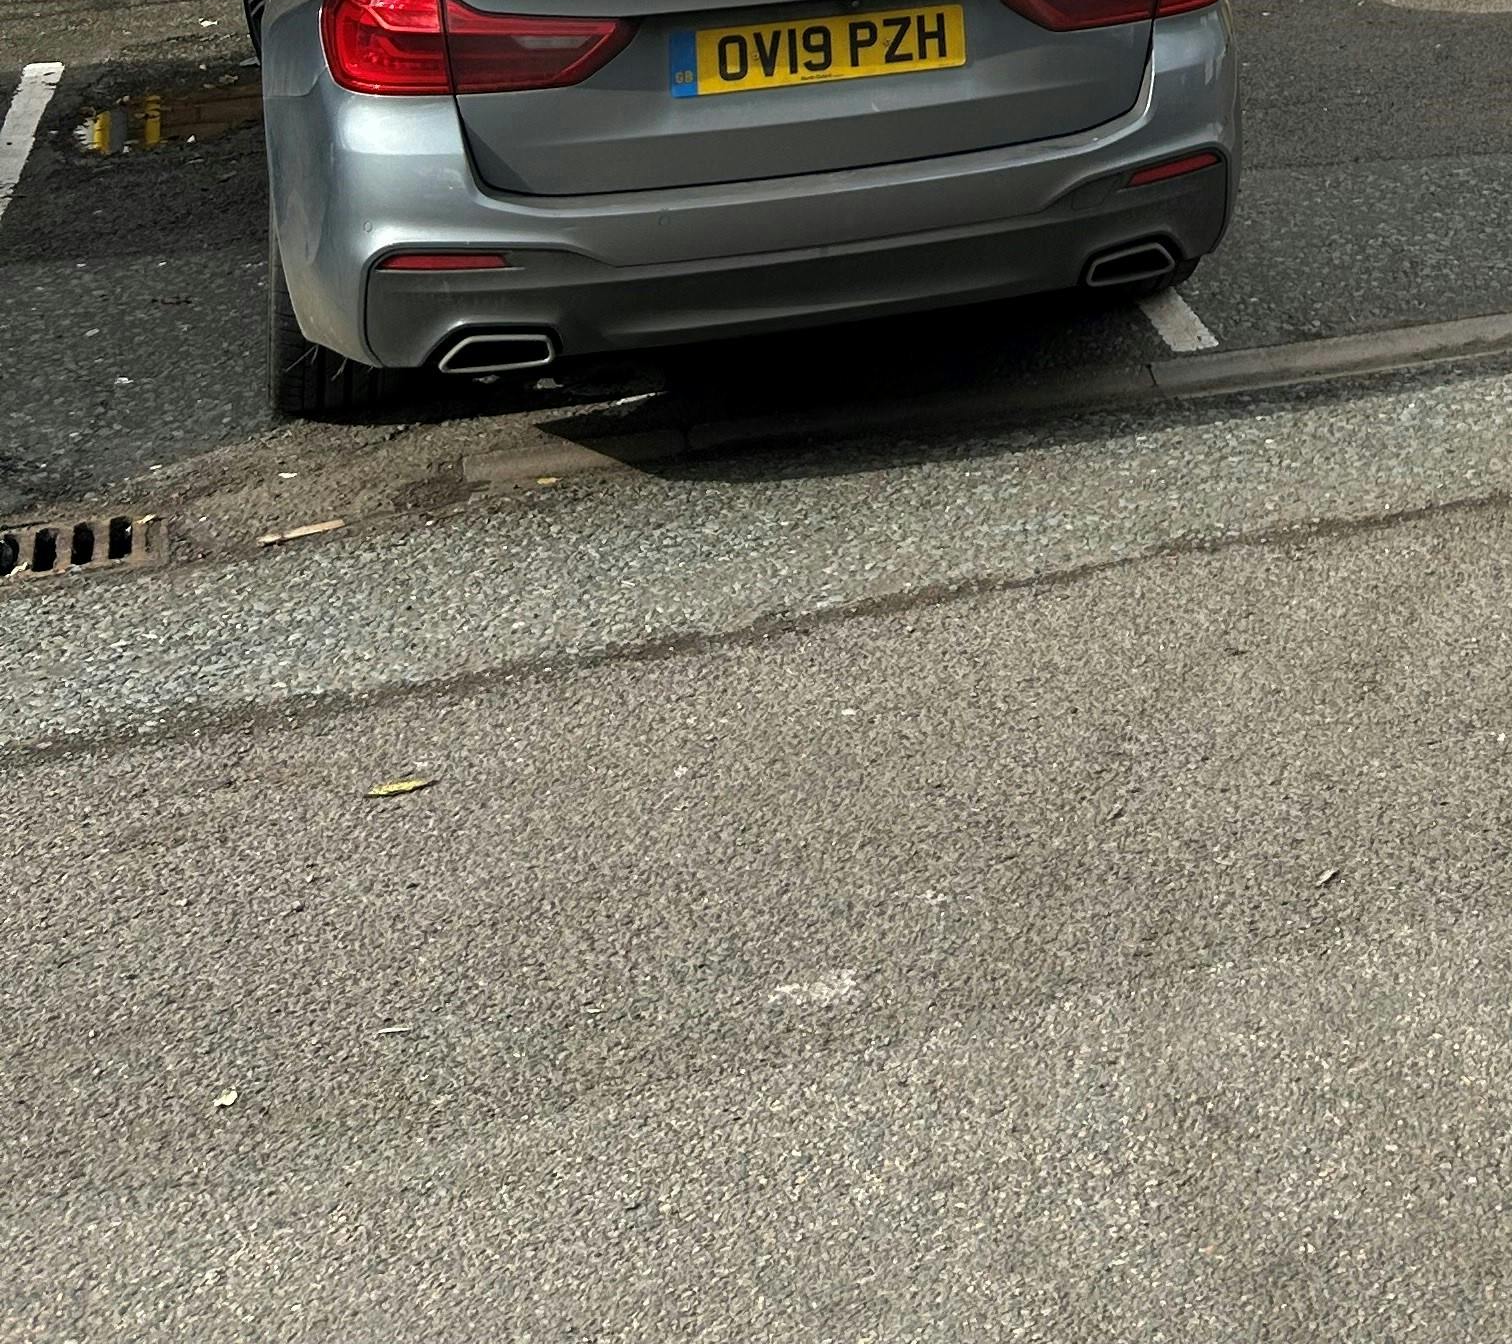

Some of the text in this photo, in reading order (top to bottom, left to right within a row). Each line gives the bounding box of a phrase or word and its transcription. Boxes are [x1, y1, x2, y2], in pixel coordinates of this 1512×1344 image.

[718, 13, 946, 81] OV19 PZH
[675, 70, 693, 83] GB
